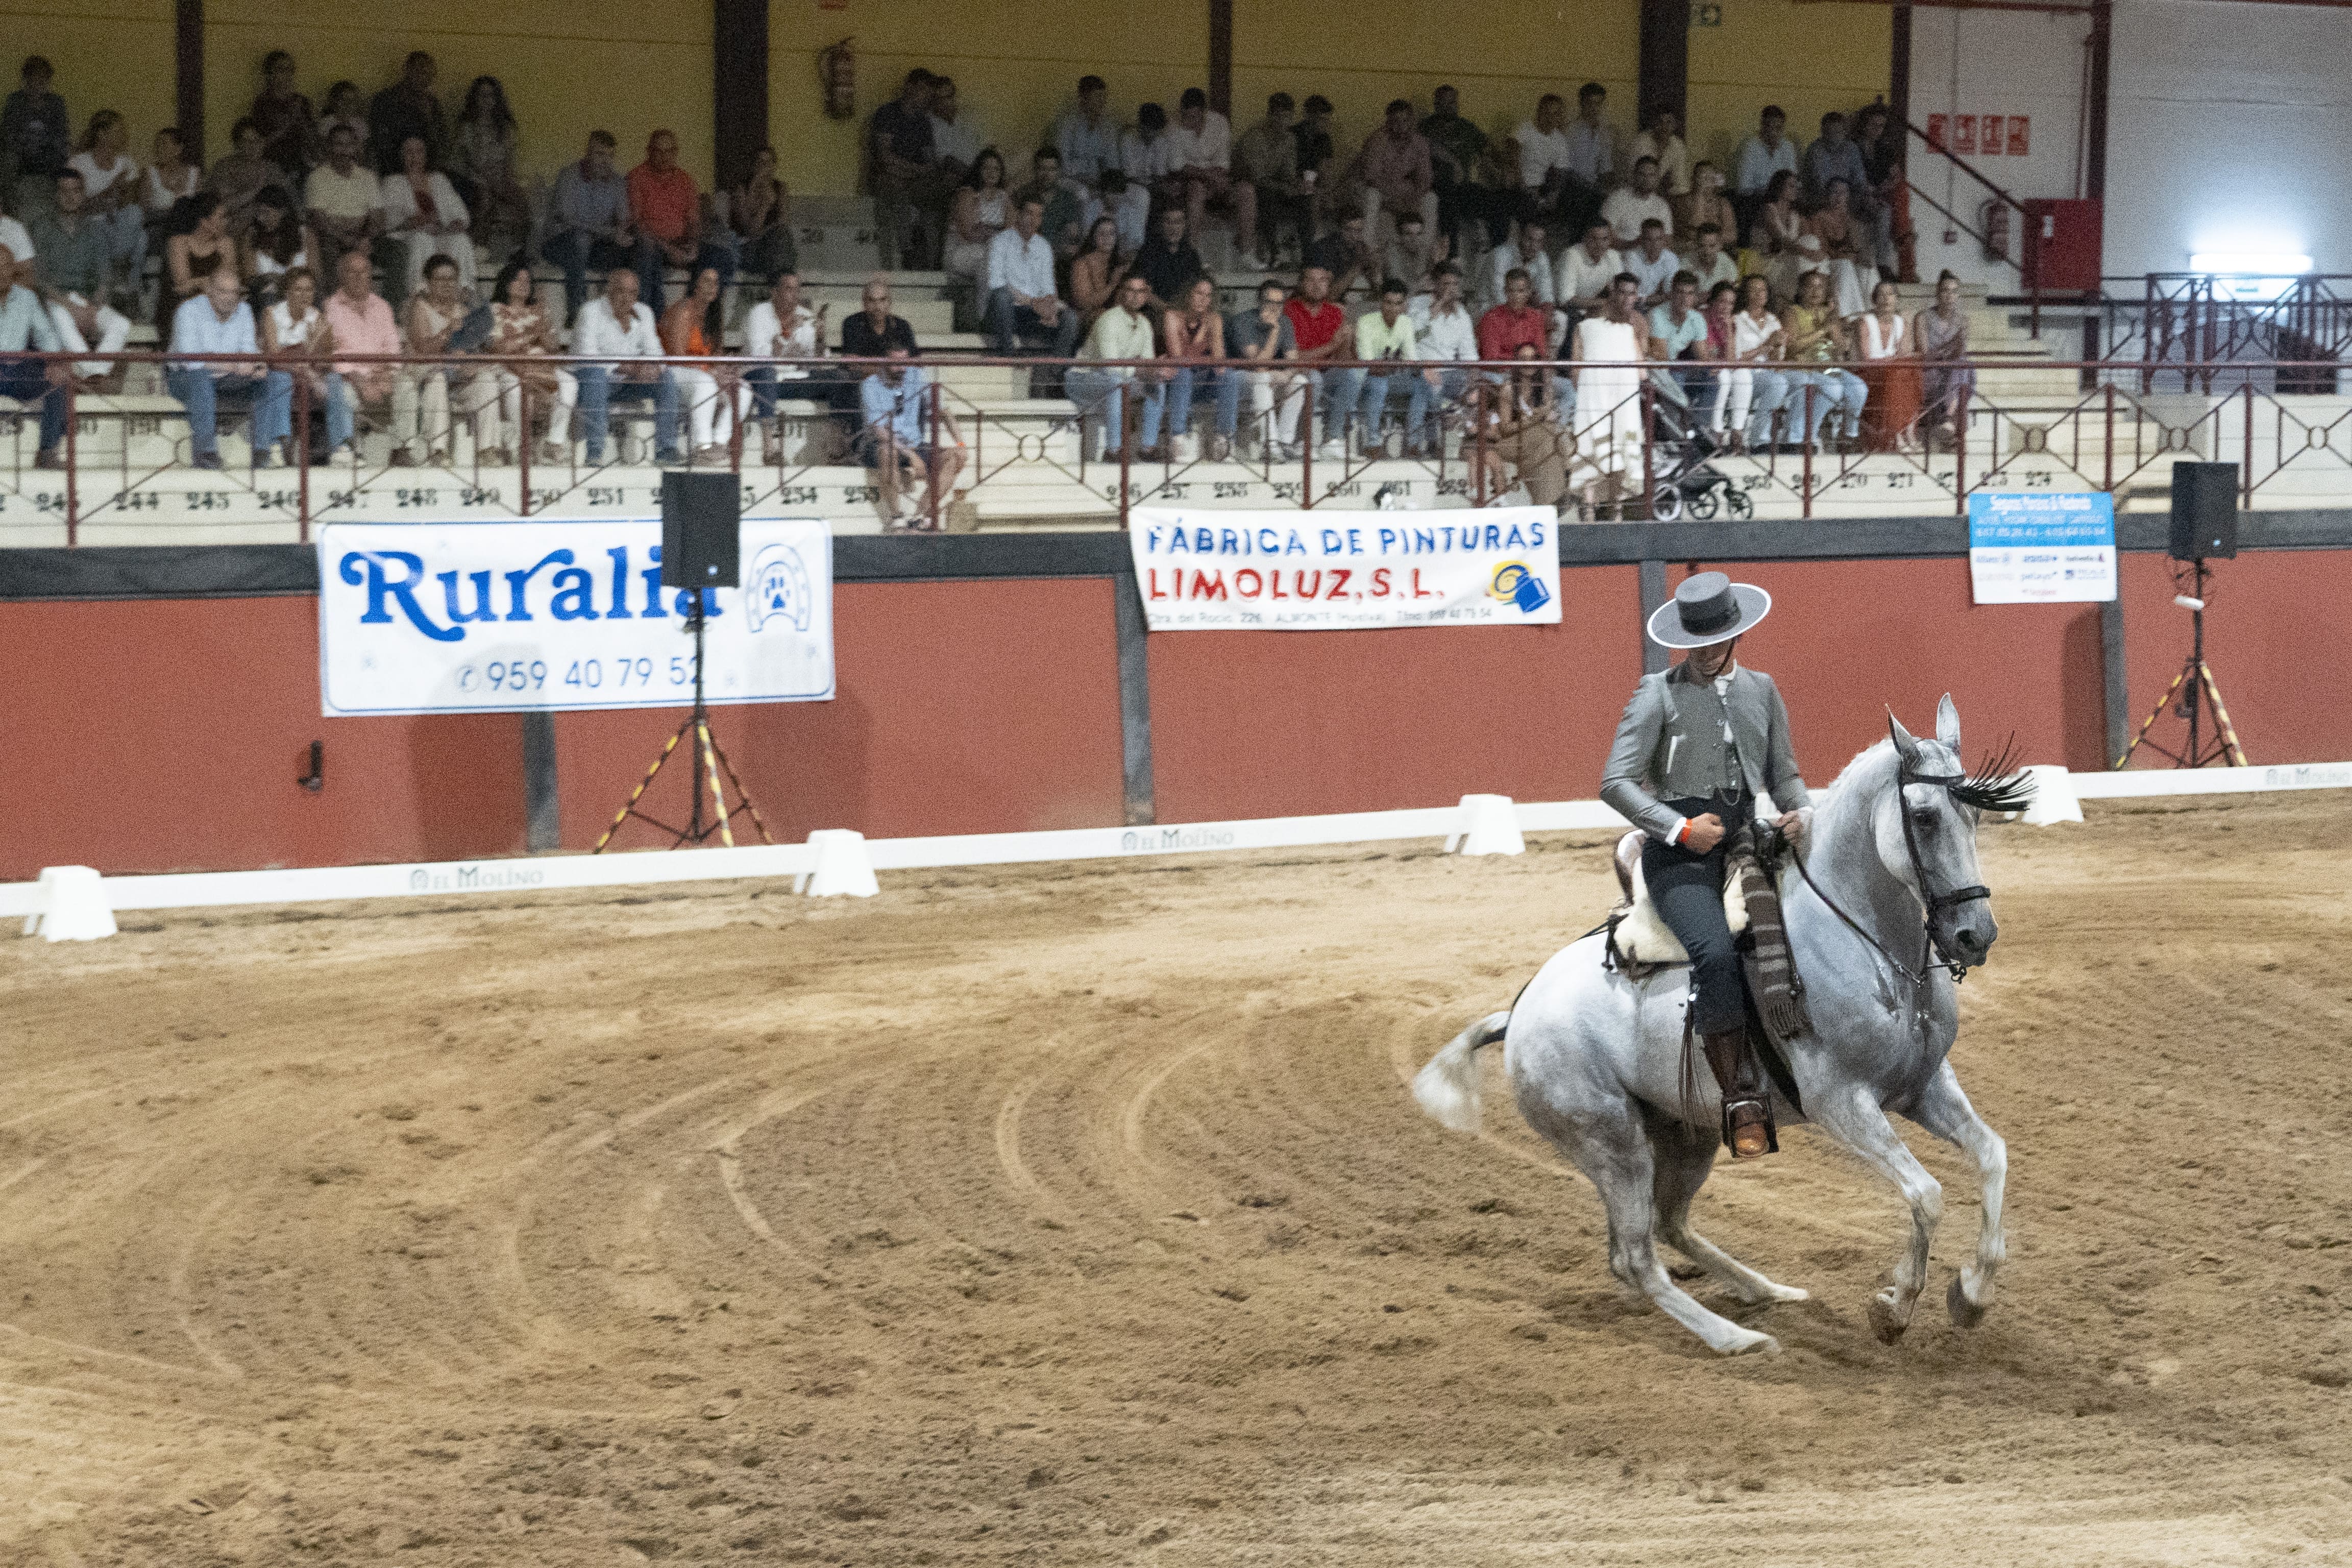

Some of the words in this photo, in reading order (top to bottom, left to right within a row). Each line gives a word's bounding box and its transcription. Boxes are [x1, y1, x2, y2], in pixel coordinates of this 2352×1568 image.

[1791, 474, 1821, 490] 29
[1938, 471, 1956, 488] 27
[113, 492, 159, 510] 244
[186, 491, 229, 509] 245
[258, 490, 302, 509] 246
[396, 488, 437, 507] 248
[459, 487, 500, 506] 249
[588, 487, 623, 505] 251
[781, 486, 817, 504] 254
[1107, 483, 1141, 502] 26
[36, 493, 81, 511] 24
[1147, 517, 1306, 555] FÁBRICA
[1321, 528, 1363, 556] DE
[1381, 521, 1545, 555] PINTURAS
[340, 545, 722, 642] Ruralia
[487, 659, 547, 692] 959
[565, 658, 602, 688] 40
[617, 657, 653, 687] 79
